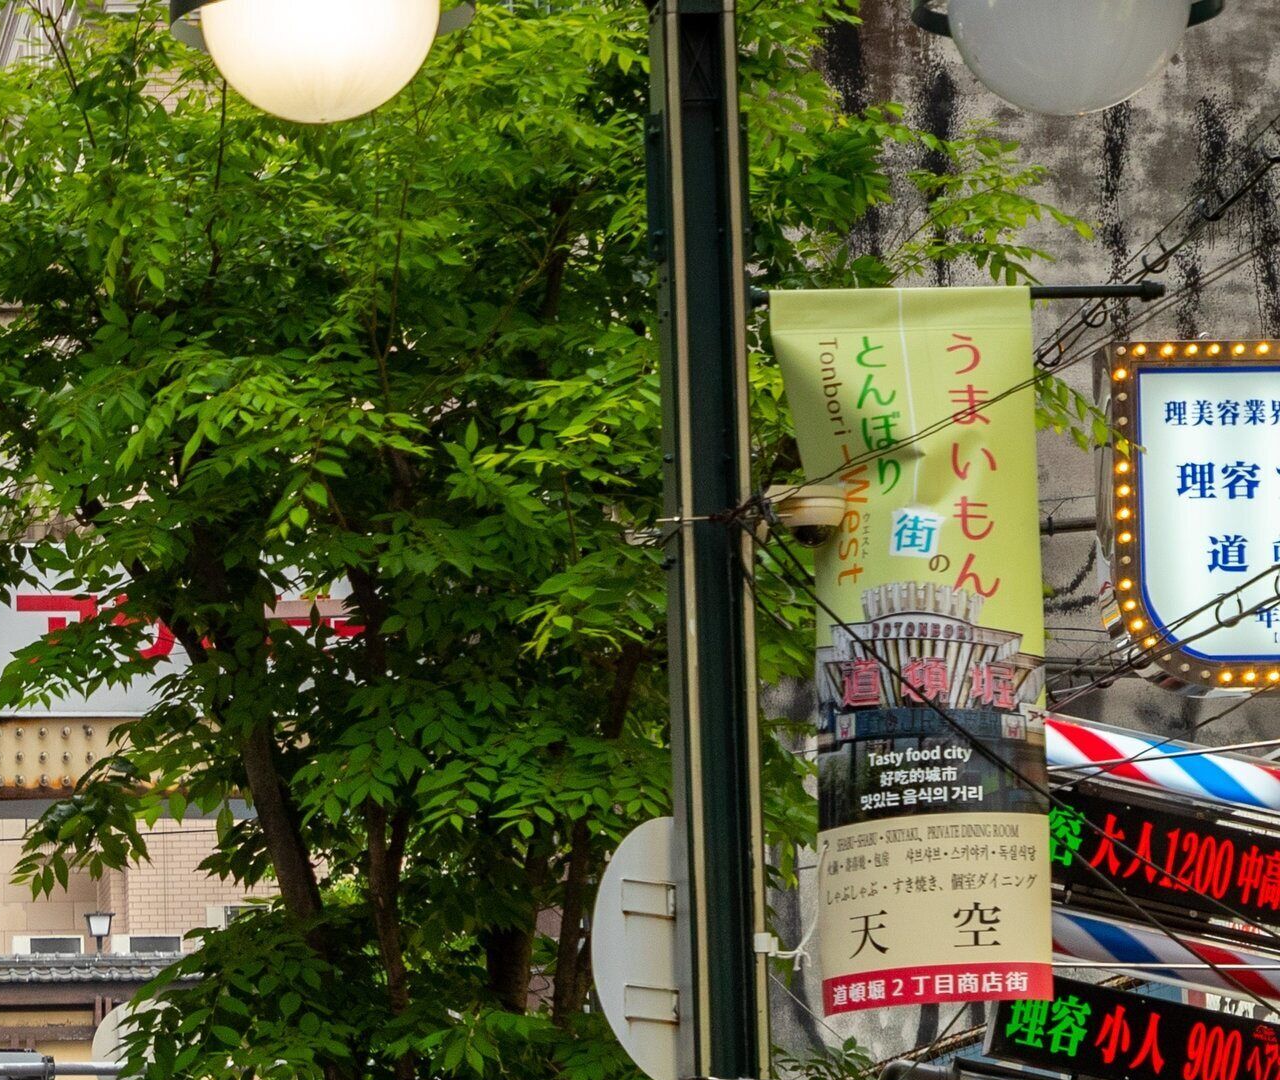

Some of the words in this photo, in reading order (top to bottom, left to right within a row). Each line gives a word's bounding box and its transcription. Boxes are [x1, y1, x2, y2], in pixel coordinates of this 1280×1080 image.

[818, 337, 852, 437] Tonbori
[855, 335, 902, 496] とんぼり
[946, 333, 1001, 598] うまいもん
[893, 512, 937, 554] 街
[929, 554, 951, 574] の
[841, 655, 1017, 710] 道頓堀
[868, 750, 904, 771] Tasty
[905, 747, 942, 766] food
[943, 744, 973, 766] city
[879, 767, 958, 789] 好吃的城市
[860, 790, 901, 812] 맛있는
[902, 787, 948, 807] 음식의
[950, 784, 984, 805] 거리
[1095, 1004, 1166, 1076] 小人
